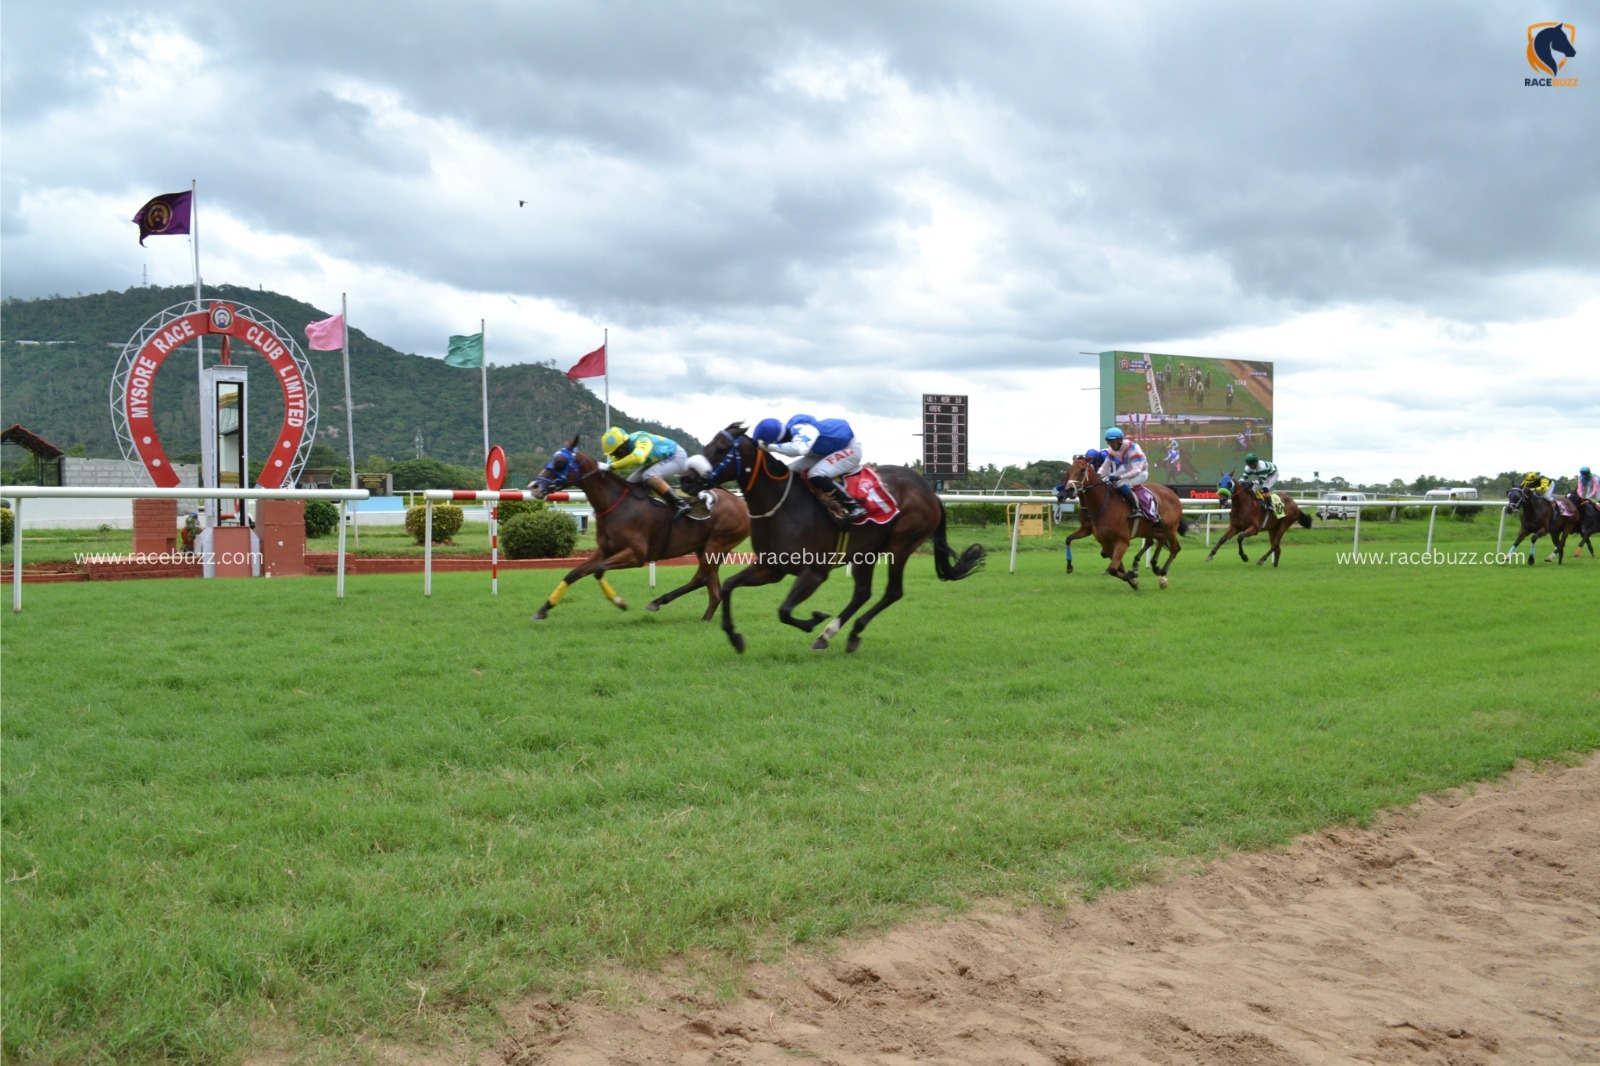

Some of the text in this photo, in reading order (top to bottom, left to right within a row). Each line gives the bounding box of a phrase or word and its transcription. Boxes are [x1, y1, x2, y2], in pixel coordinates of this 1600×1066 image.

[130, 319, 304, 428] MYSORE RACE CLUB LIMITED
[866, 487, 892, 514] 1
